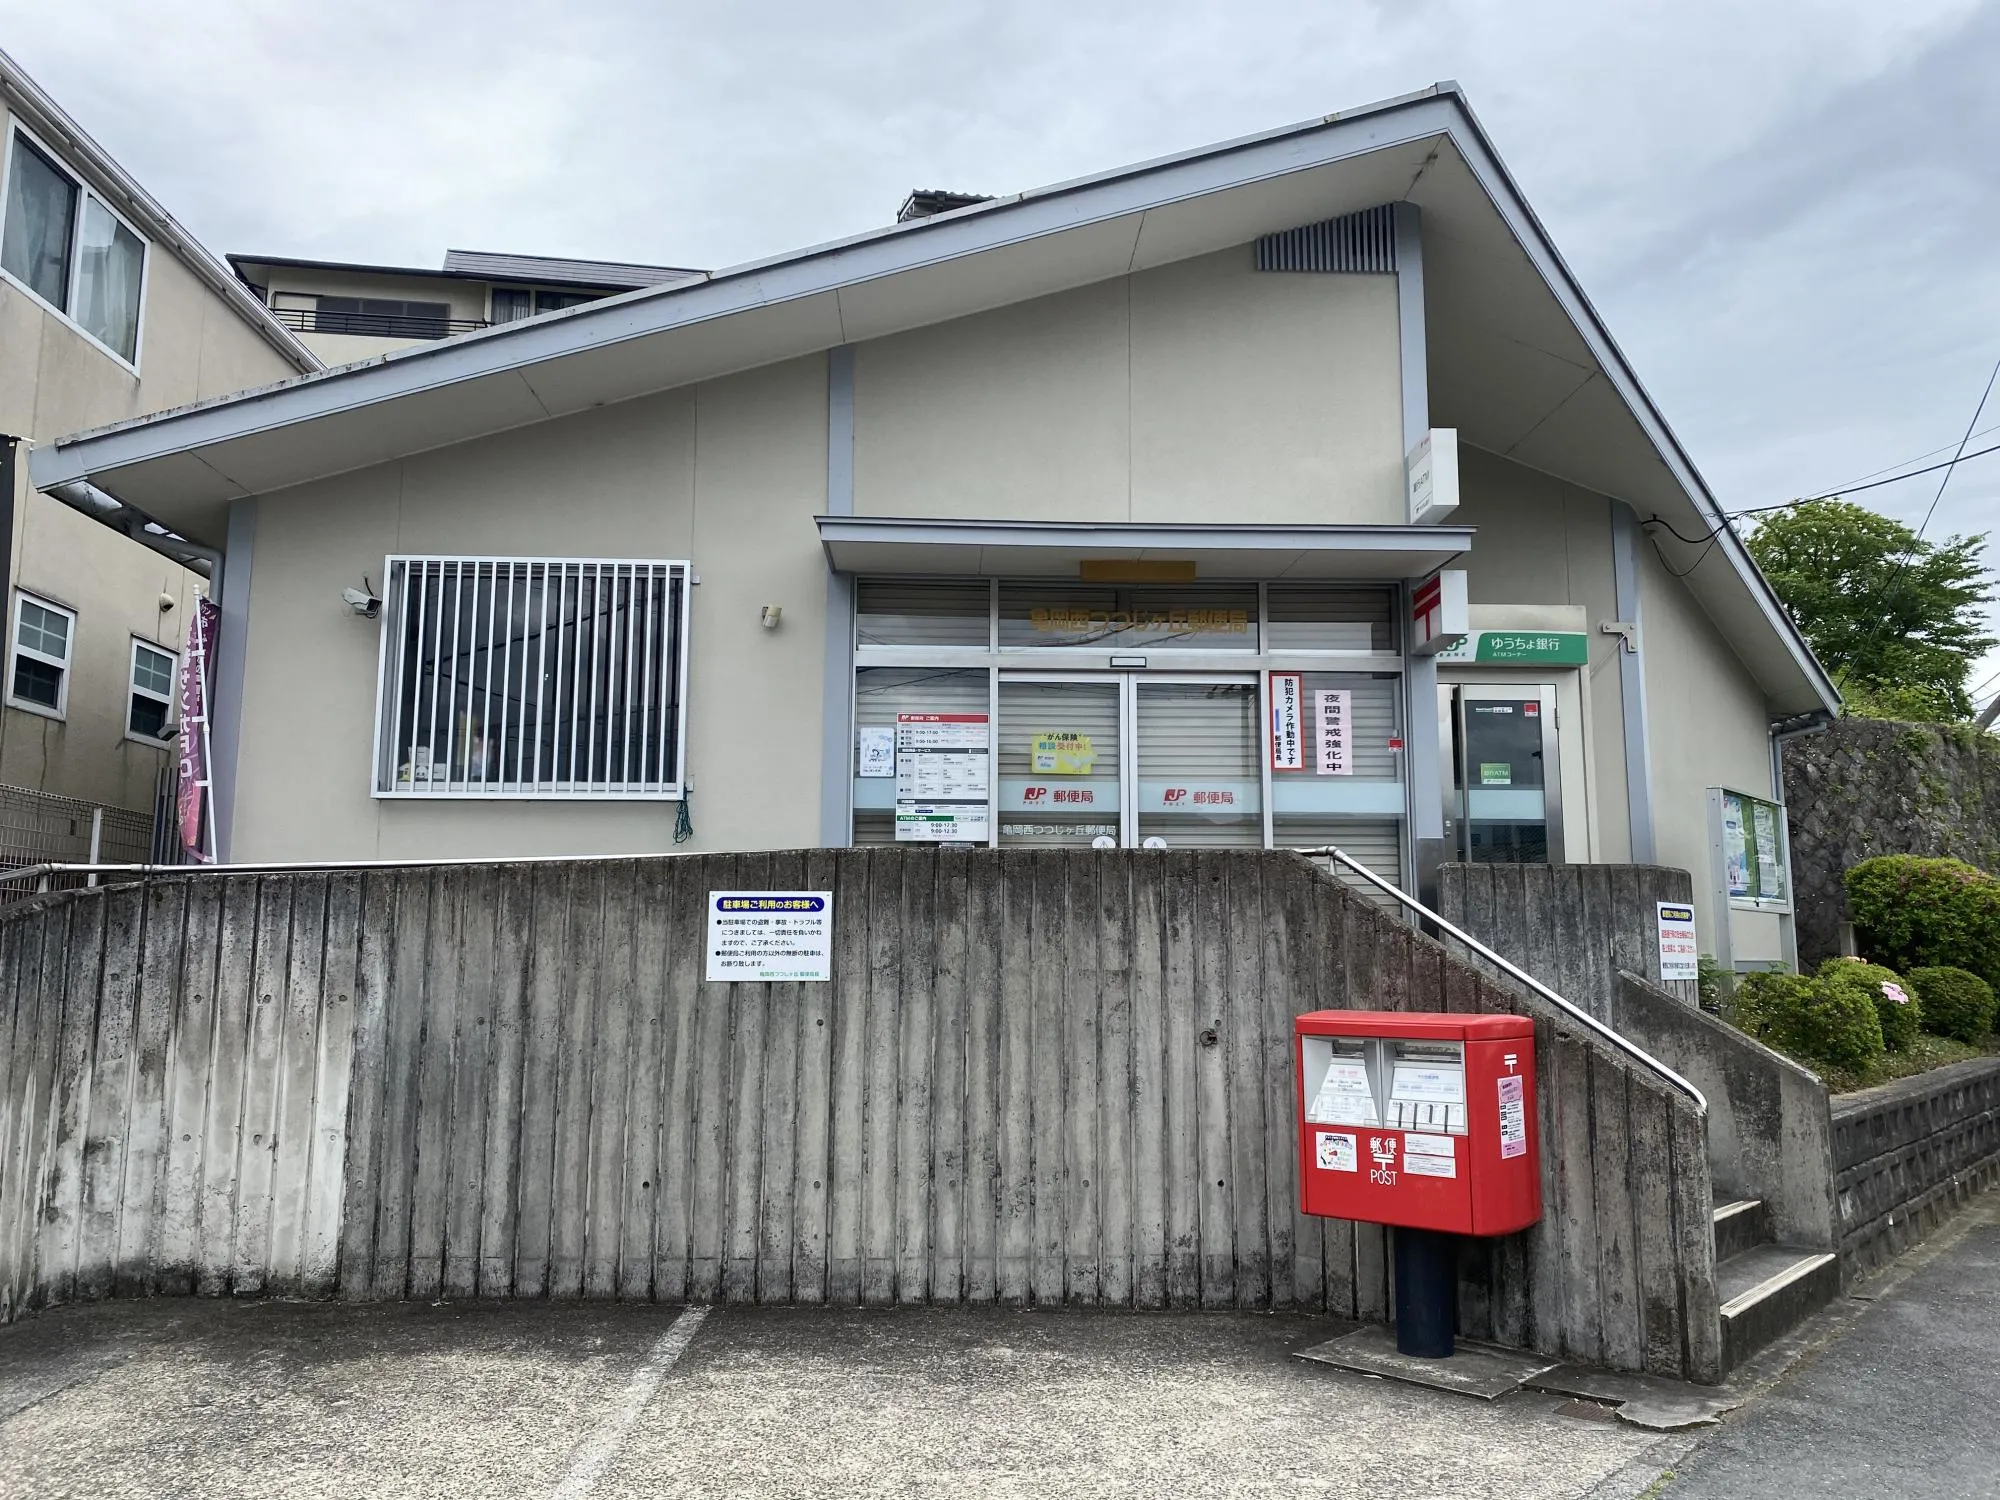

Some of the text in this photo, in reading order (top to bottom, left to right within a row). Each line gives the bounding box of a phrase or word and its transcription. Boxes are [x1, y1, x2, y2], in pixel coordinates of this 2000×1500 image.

[1491, 637, 1560, 650] ゆうちょ銀行
[1284, 678, 1295, 765] 防犯カメラ作動中です
[1324, 694, 1342, 771] 夜間警戒強化中
[1024, 787, 1093, 803] JP 郵便局
[1164, 789, 1233, 804] JP 郵便局
[1002, 824, 1117, 836] 亀岡西つつじヶ丘郵便局
[723, 900, 819, 909] 駐車場ご利用のお客様へ
[1370, 1137, 1397, 1155] 郵便
[1370, 1169, 1397, 1186] POST
